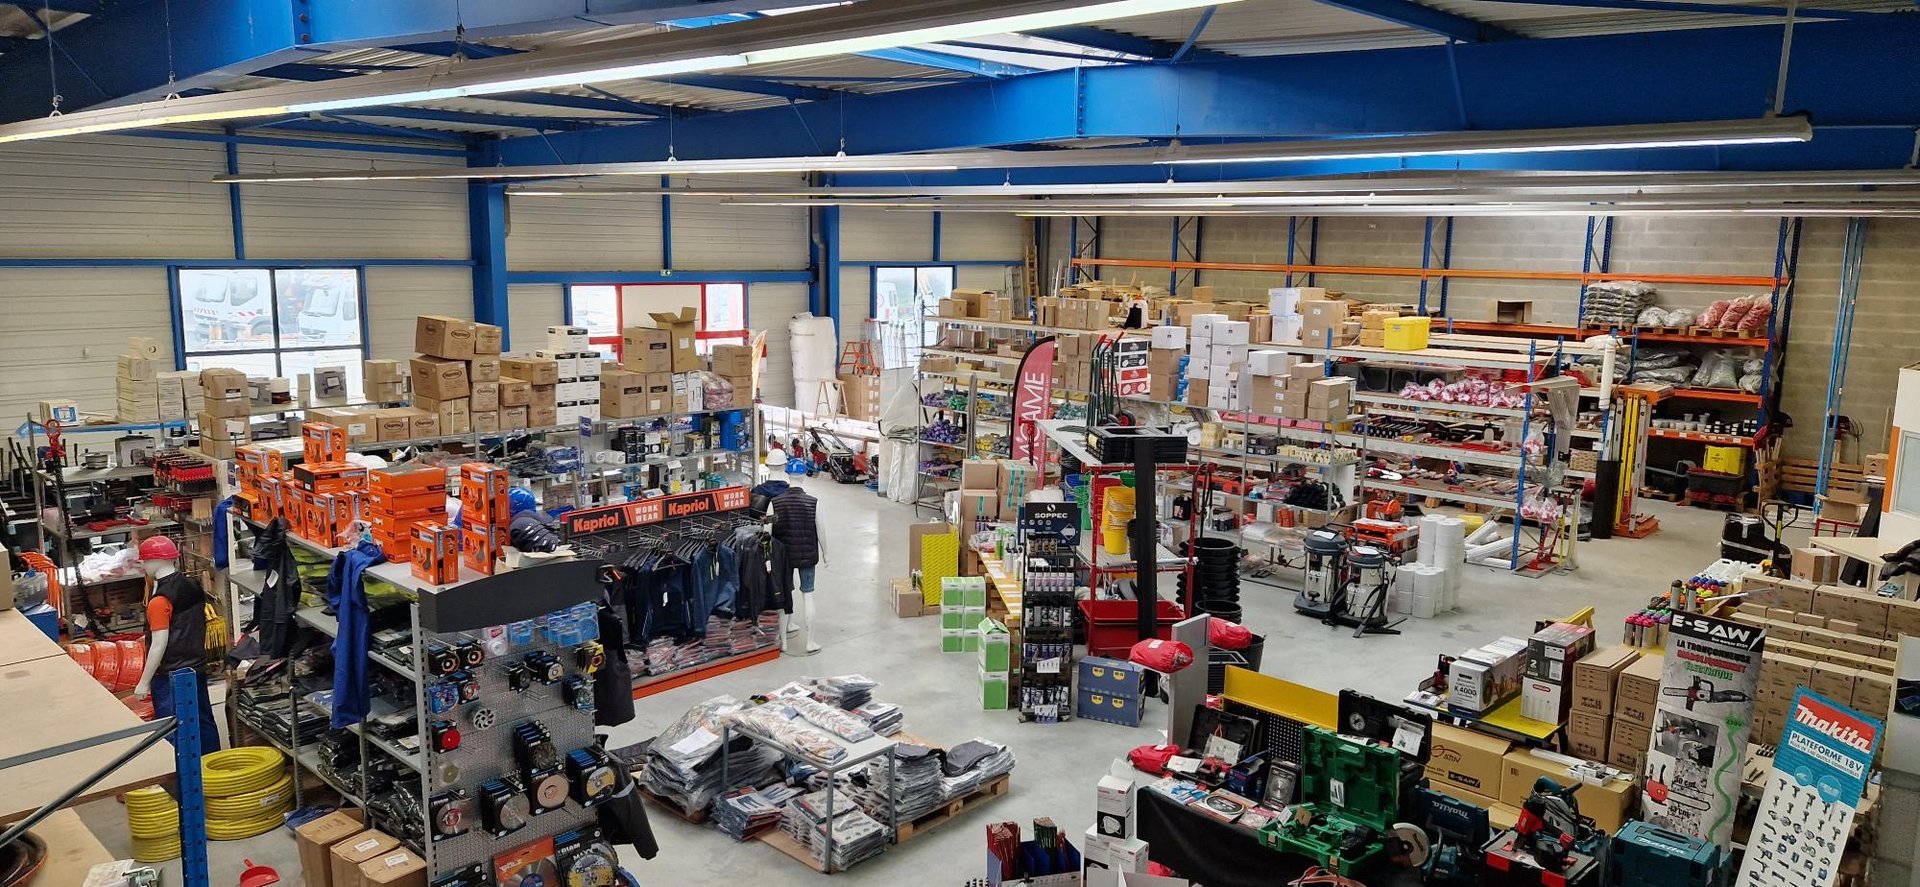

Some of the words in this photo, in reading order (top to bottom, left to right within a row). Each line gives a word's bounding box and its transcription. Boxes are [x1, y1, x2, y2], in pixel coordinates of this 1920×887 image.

[723, 491, 745, 501] WORK
[723, 498, 745, 508] WEAR
[634, 504, 658, 514] WORK
[669, 498, 709, 516] Kapriol
[574, 513, 618, 532] Kapriol
[635, 512, 659, 523] WEAR
[1672, 614, 1751, 642] E-SAW
[1791, 733, 1843, 763] PLATEFORME
